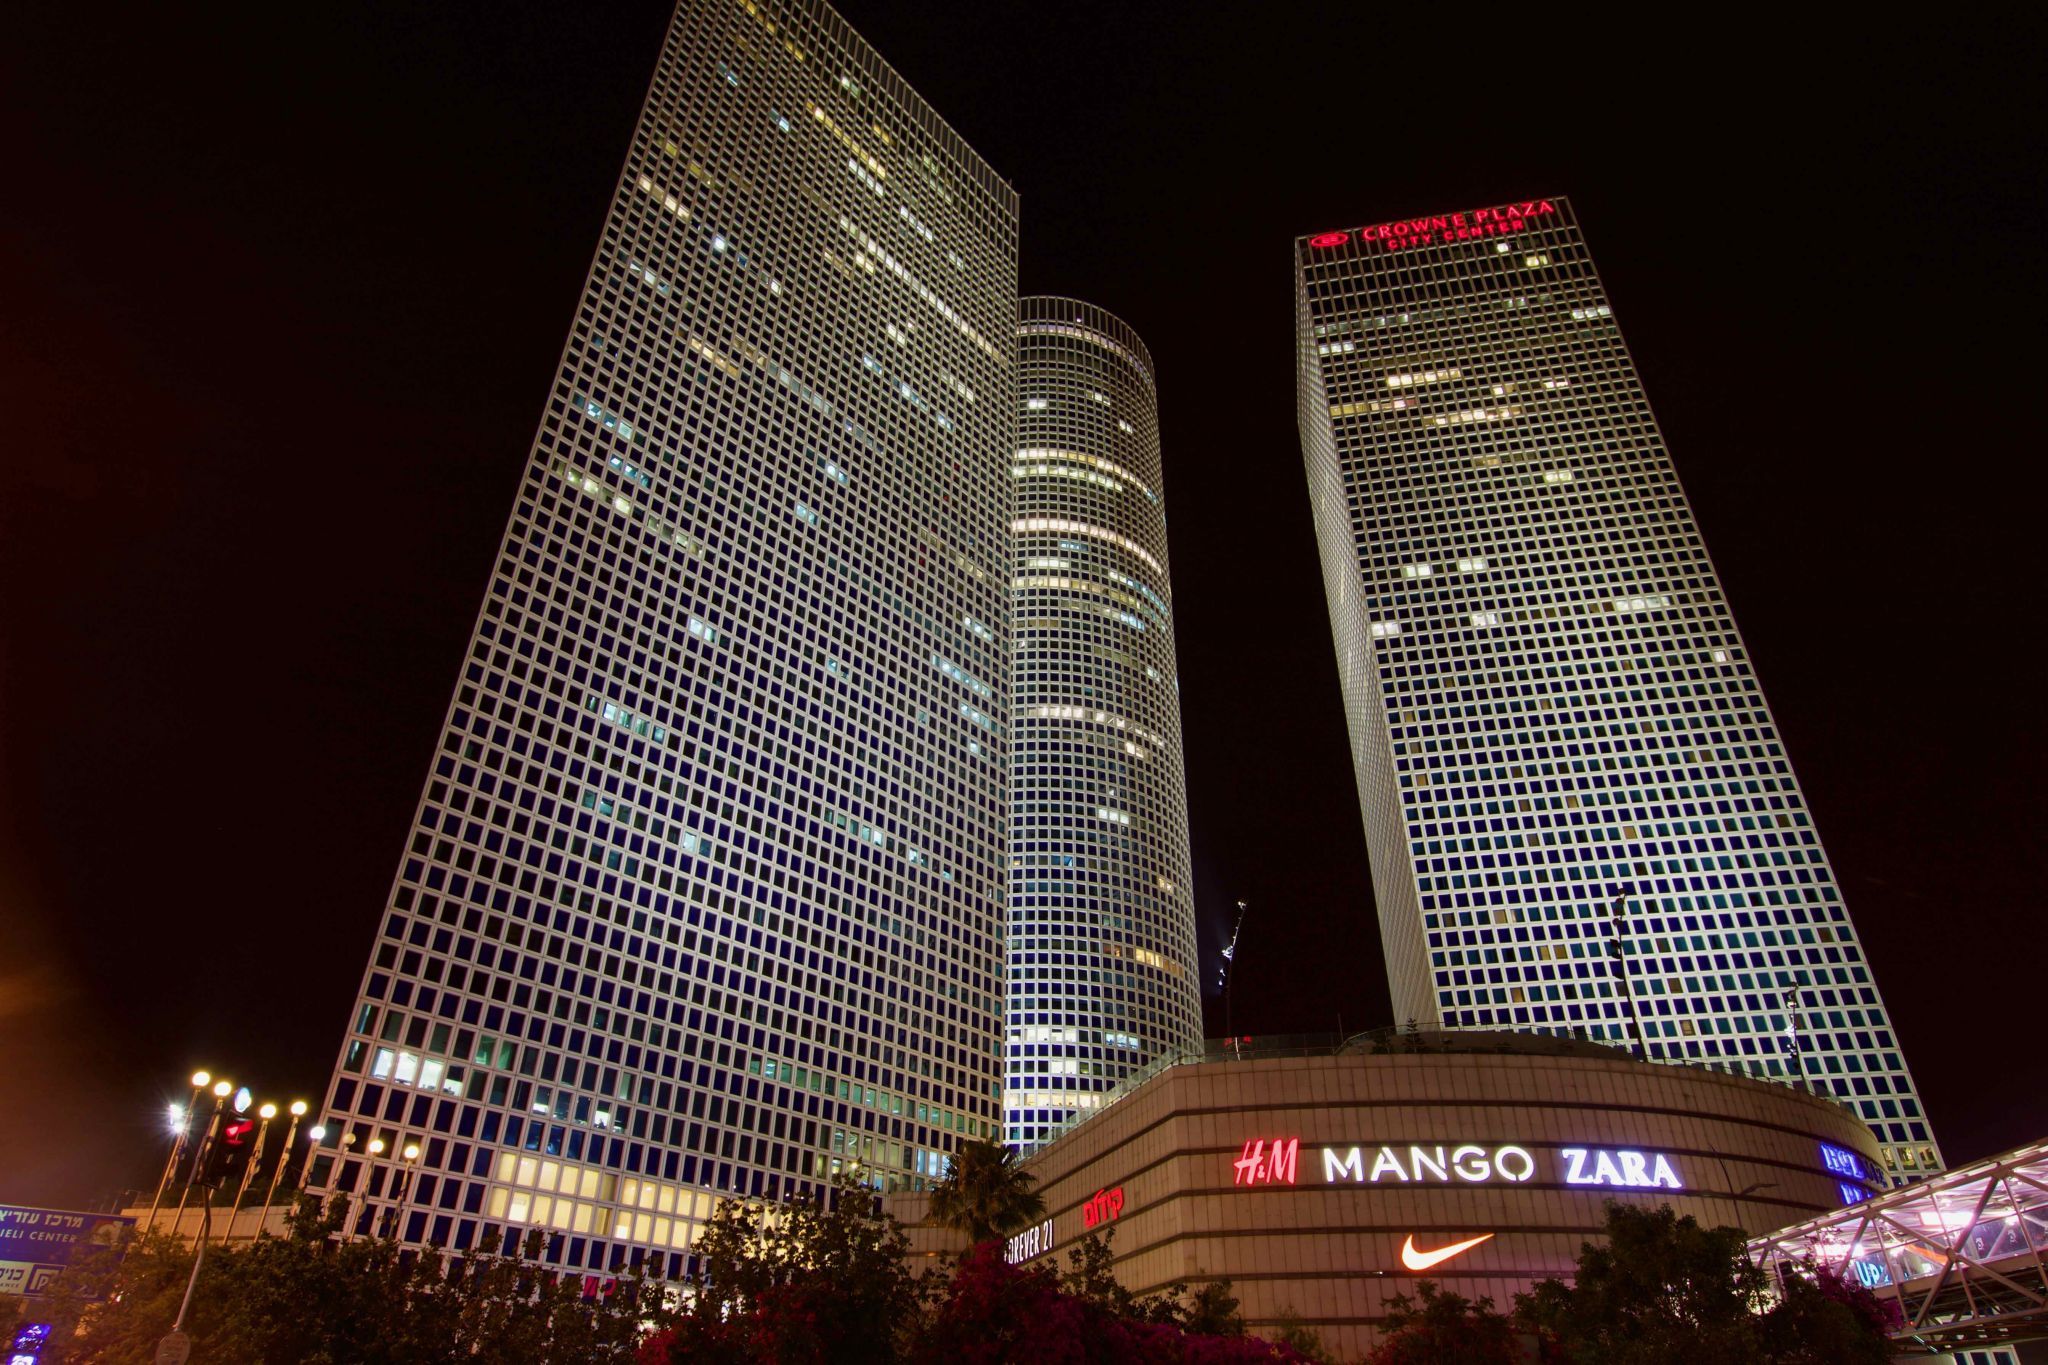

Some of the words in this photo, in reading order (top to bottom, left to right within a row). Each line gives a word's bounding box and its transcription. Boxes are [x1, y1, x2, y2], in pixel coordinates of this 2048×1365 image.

[1362, 214, 1466, 241] CROWNE
[1476, 200, 1553, 223] PLAZA
[1388, 232, 1432, 250] CITY
[1443, 219, 1525, 241] CENTER
[1234, 1138, 1300, 1185] H&M
[1324, 1146, 1535, 1182] MANGO
[1562, 1148, 1683, 1189] ZARA
[29, 1231, 78, 1243] CENTER
[45, 1214, 84, 1228] מרכז
[1043, 1218, 1053, 1251] 21
